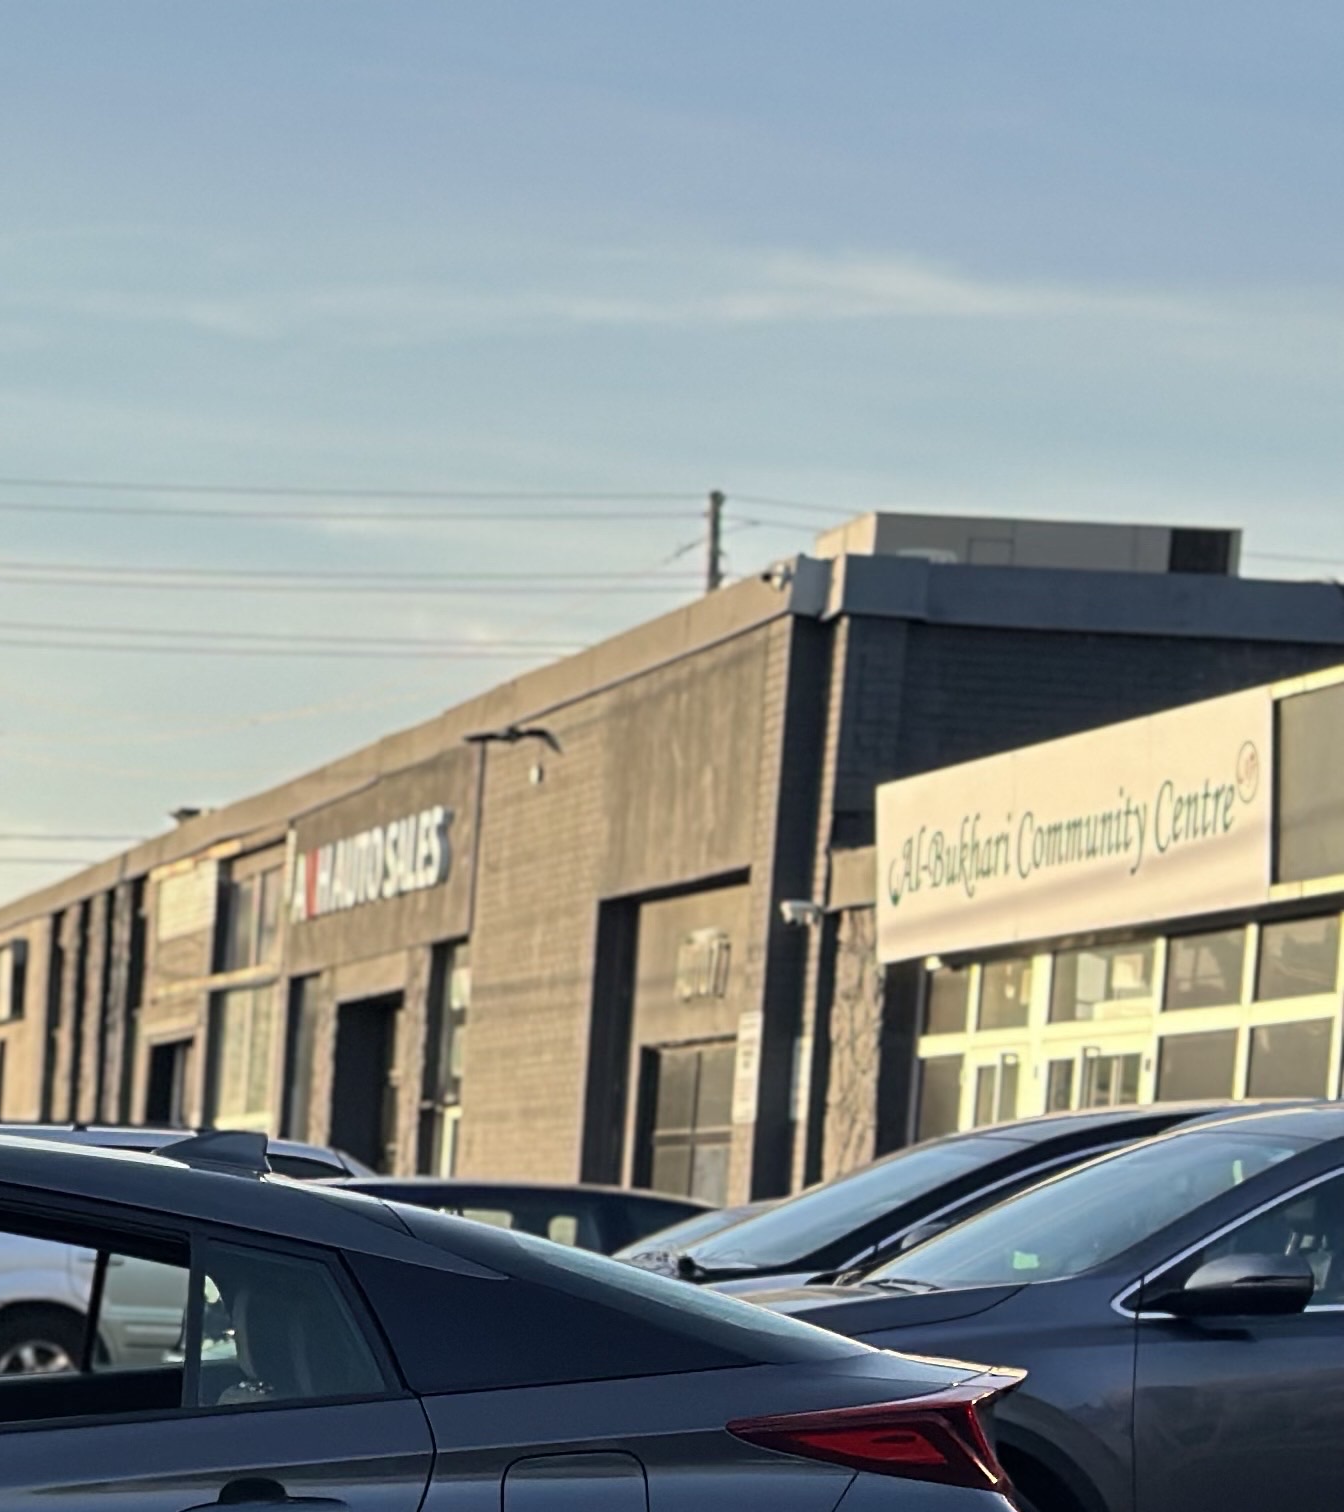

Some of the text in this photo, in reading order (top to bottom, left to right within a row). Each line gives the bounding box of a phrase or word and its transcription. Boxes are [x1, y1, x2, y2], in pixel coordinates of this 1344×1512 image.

[331, 825, 385, 909] AUTO
[381, 804, 446, 899] SALES
[888, 779, 1236, 906] Al-Bukhari Community Centre
